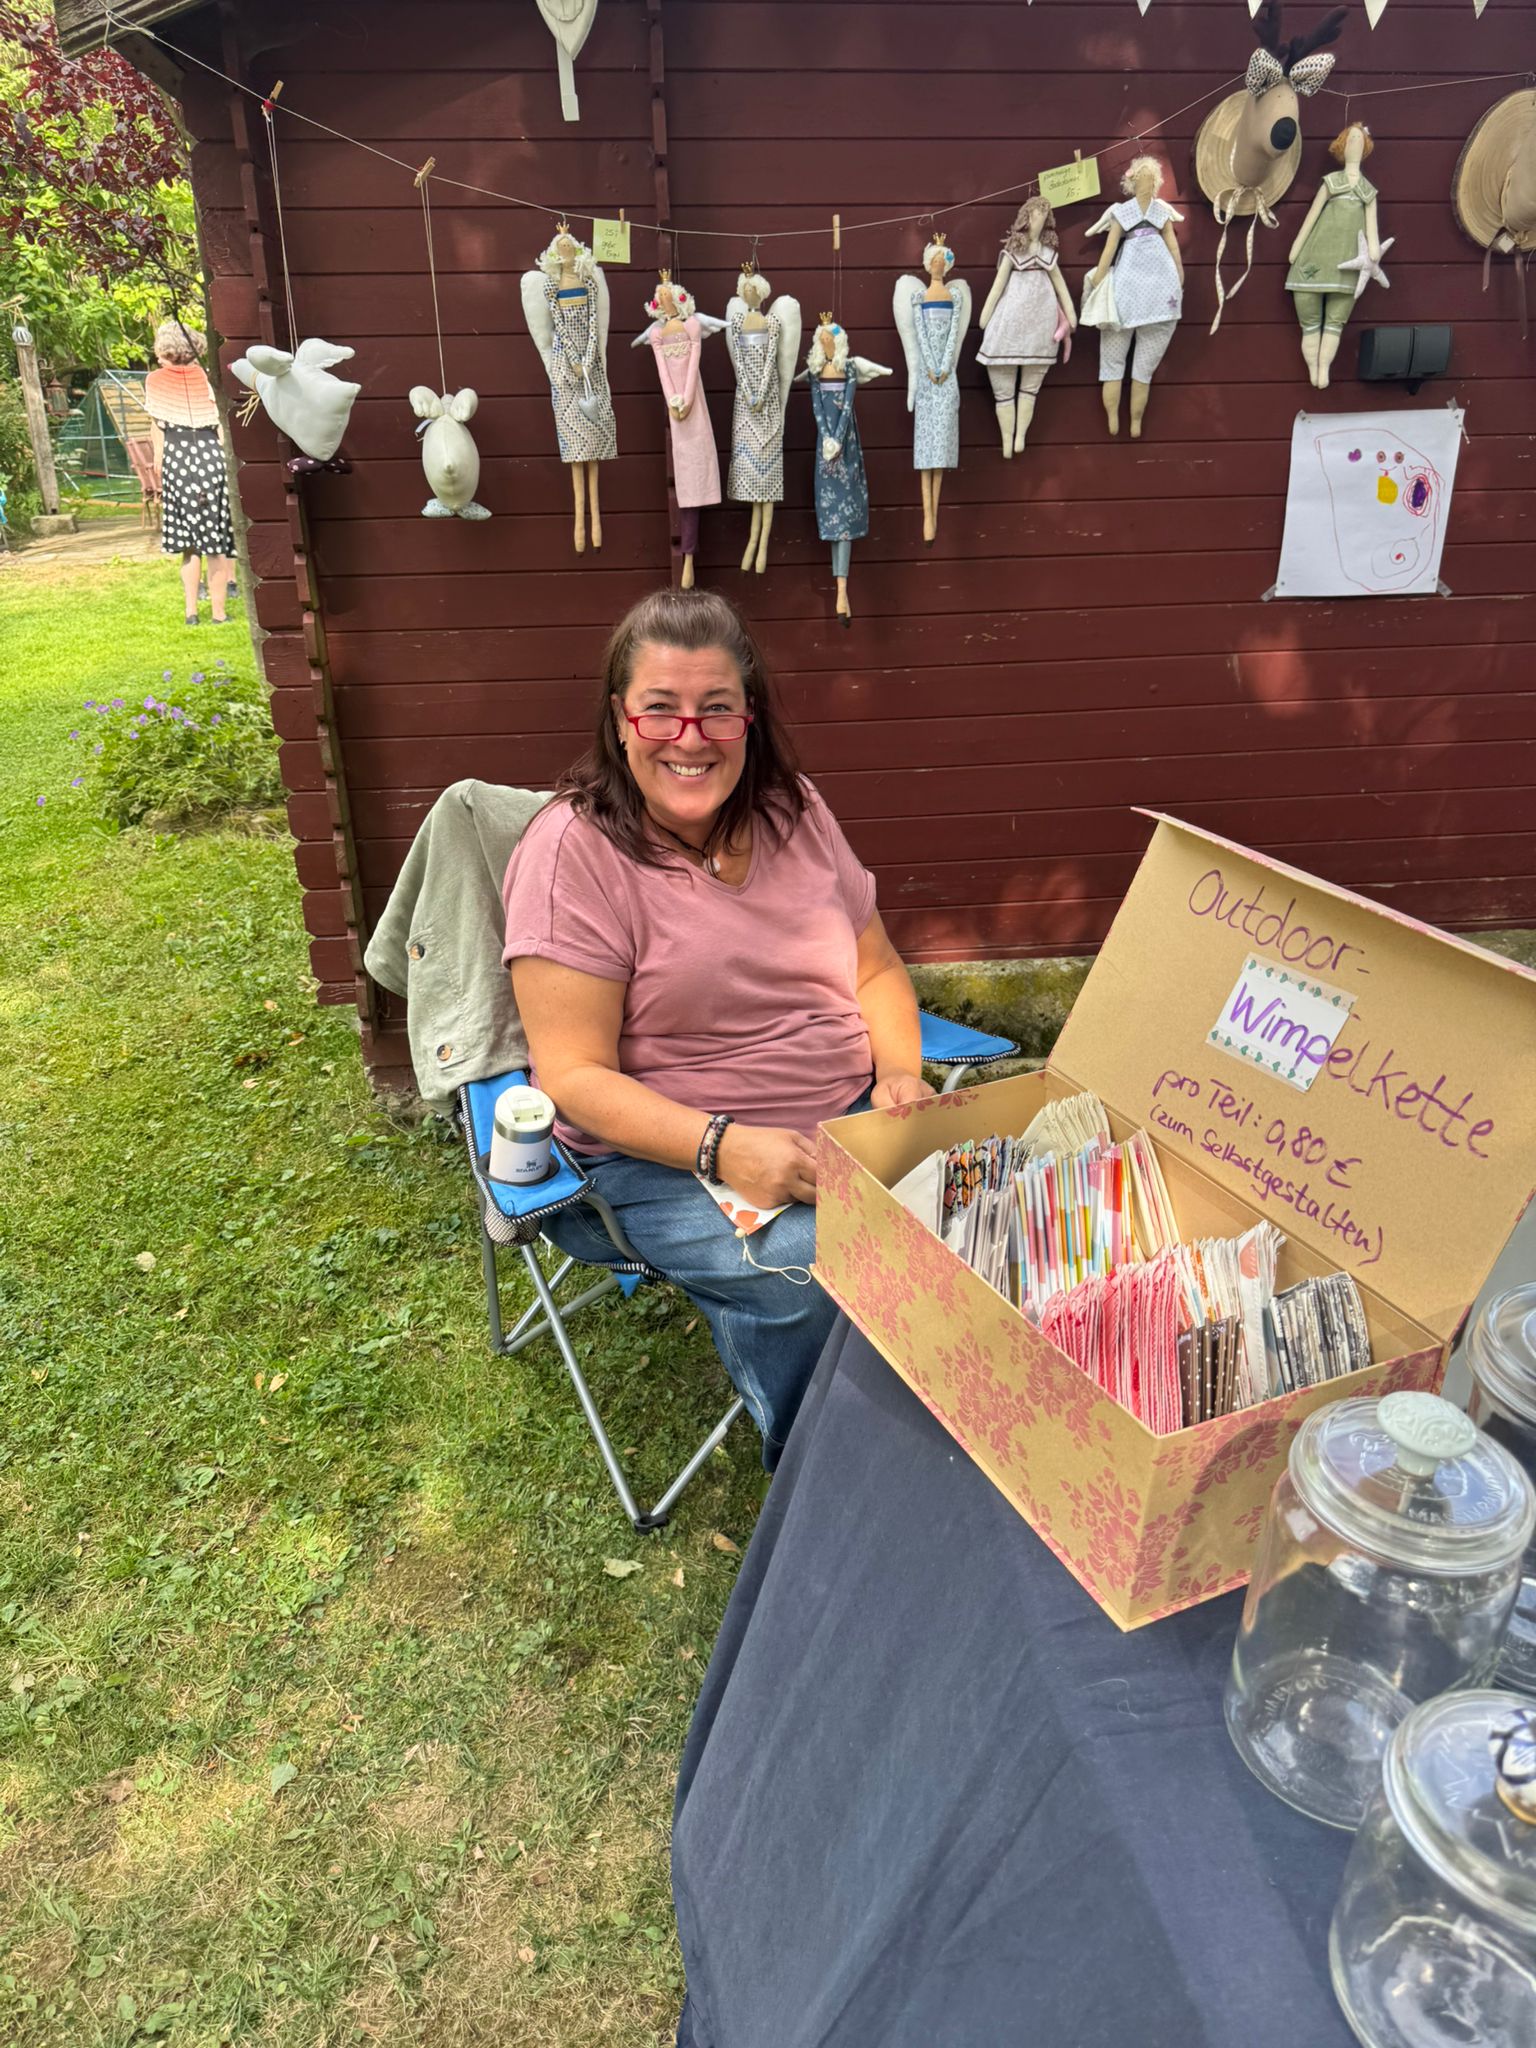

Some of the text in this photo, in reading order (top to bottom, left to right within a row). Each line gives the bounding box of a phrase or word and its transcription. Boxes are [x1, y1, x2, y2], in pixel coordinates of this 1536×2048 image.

[1188, 869, 1371, 975] Outdoor-
[1149, 1103, 1385, 1267] (zum Selbstgestalten)
[1151, 1070, 1363, 1189] pro Teil: 0,80 €
